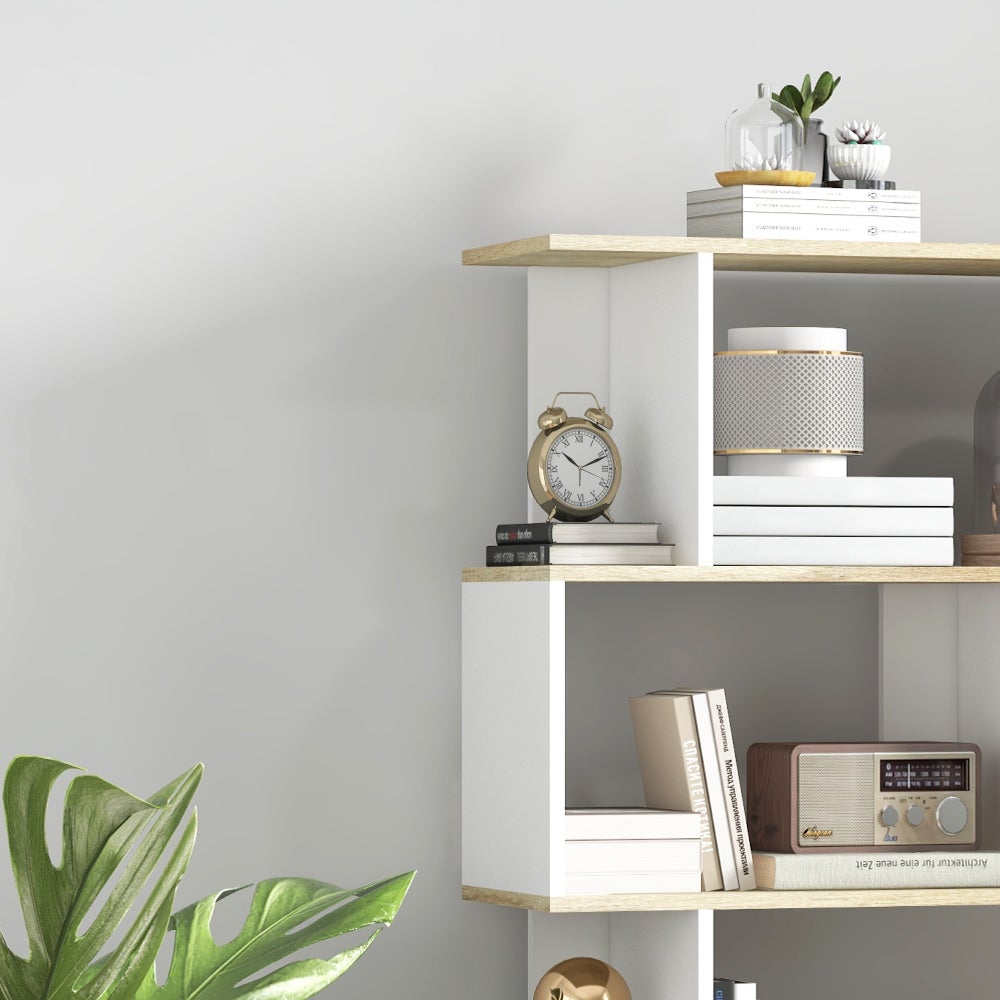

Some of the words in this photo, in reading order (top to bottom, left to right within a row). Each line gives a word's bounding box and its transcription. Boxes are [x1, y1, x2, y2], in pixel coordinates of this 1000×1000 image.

[683, 739, 704, 798] СПАСИТЕ
[725, 759, 735, 784] Метод
[735, 832, 749, 876] проектами
[855, 860, 874, 870] Zeit
[876, 860, 898, 868] neue
[900, 859, 920, 867] eine
[922, 859, 935, 868] für
[937, 858, 989, 868] Architektur
